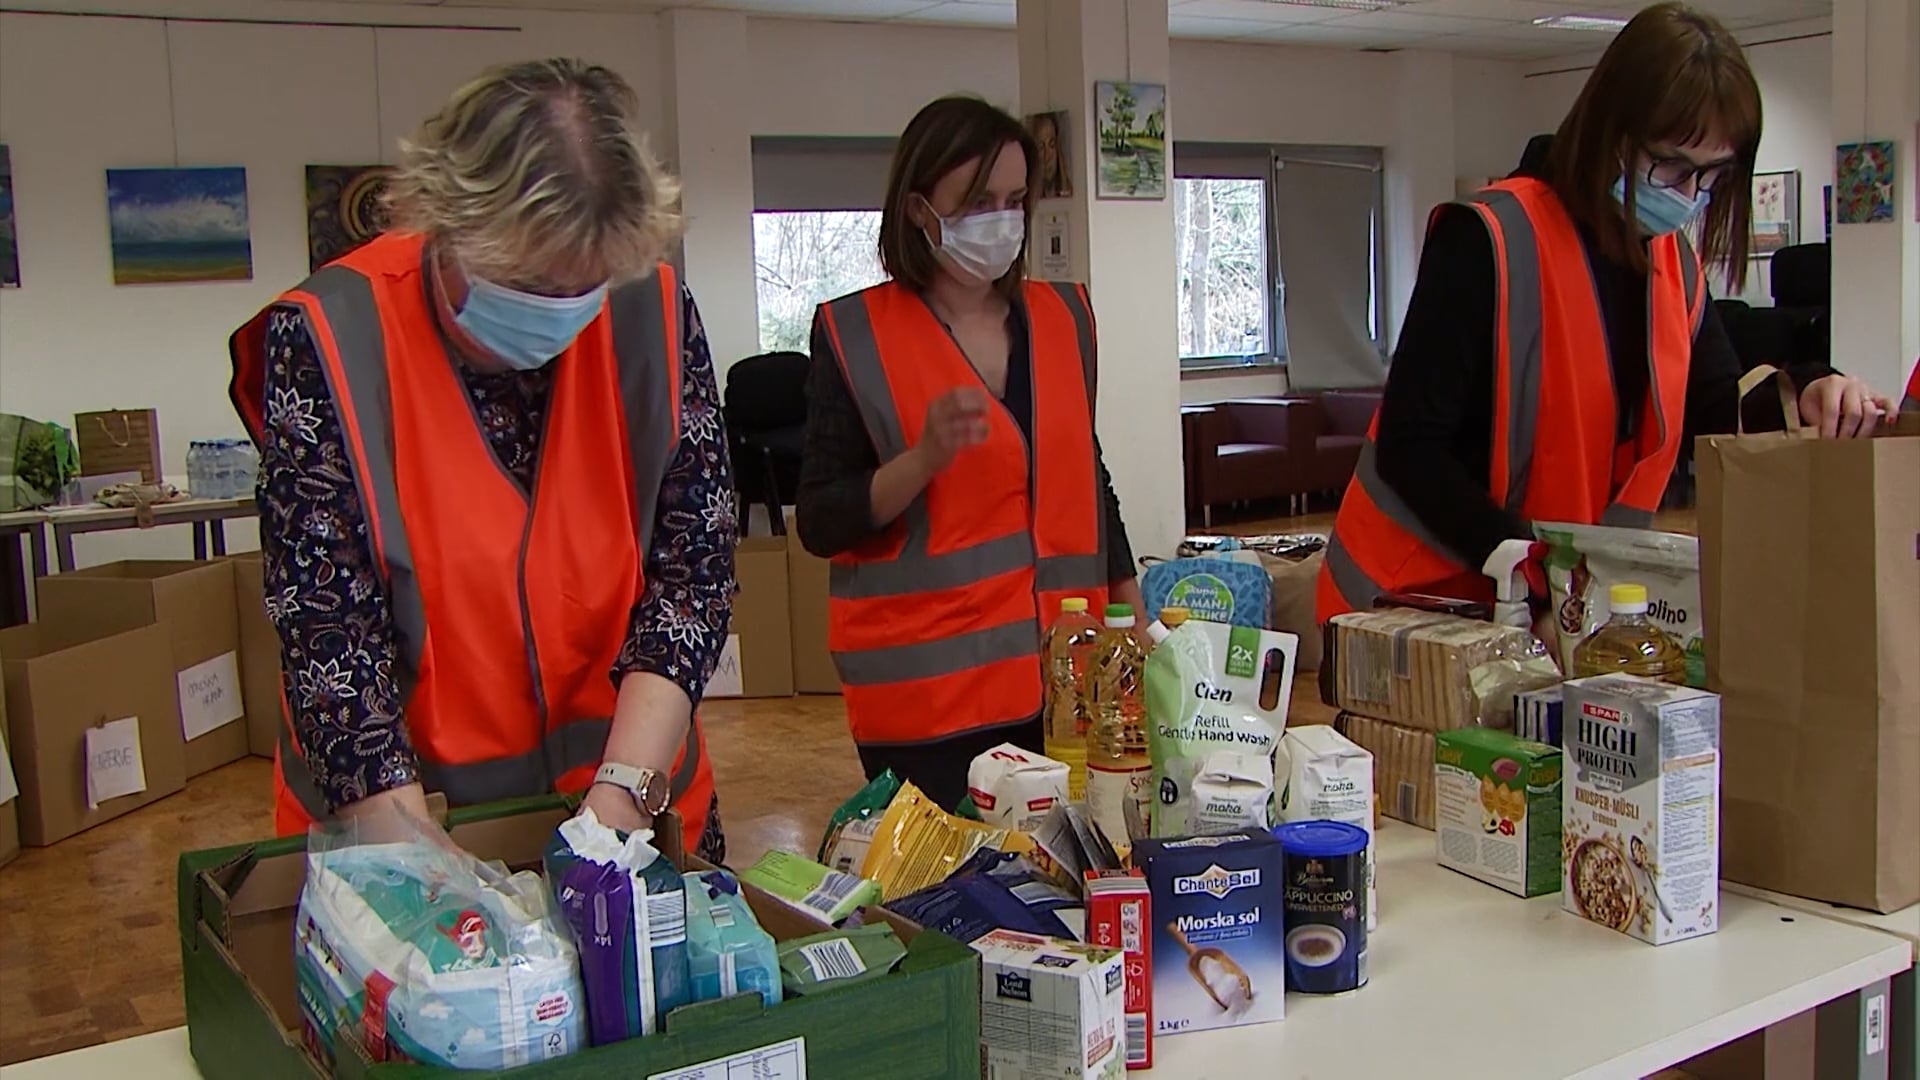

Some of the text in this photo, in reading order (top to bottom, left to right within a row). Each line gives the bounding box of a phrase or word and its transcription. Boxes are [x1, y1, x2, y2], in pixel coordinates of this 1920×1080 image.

[1184, 584, 1219, 599] Skupaj
[1191, 598, 1227, 611] MANJ
[1231, 645, 1253, 662] 2x
[1195, 714, 1230, 729] Refill
[1589, 706, 1620, 721] SPAR
[1158, 725, 1271, 747] Gentle Hand Wash
[1578, 718, 1637, 756] HIGH
[1577, 747, 1637, 778] PROTEIN
[1575, 786, 1639, 820] KNUSPER-MÜSLI
[1284, 888, 1354, 904] APPUCCINO
[1177, 906, 1260, 933] Morska sol
[1159, 1020, 1166, 1030] 1
